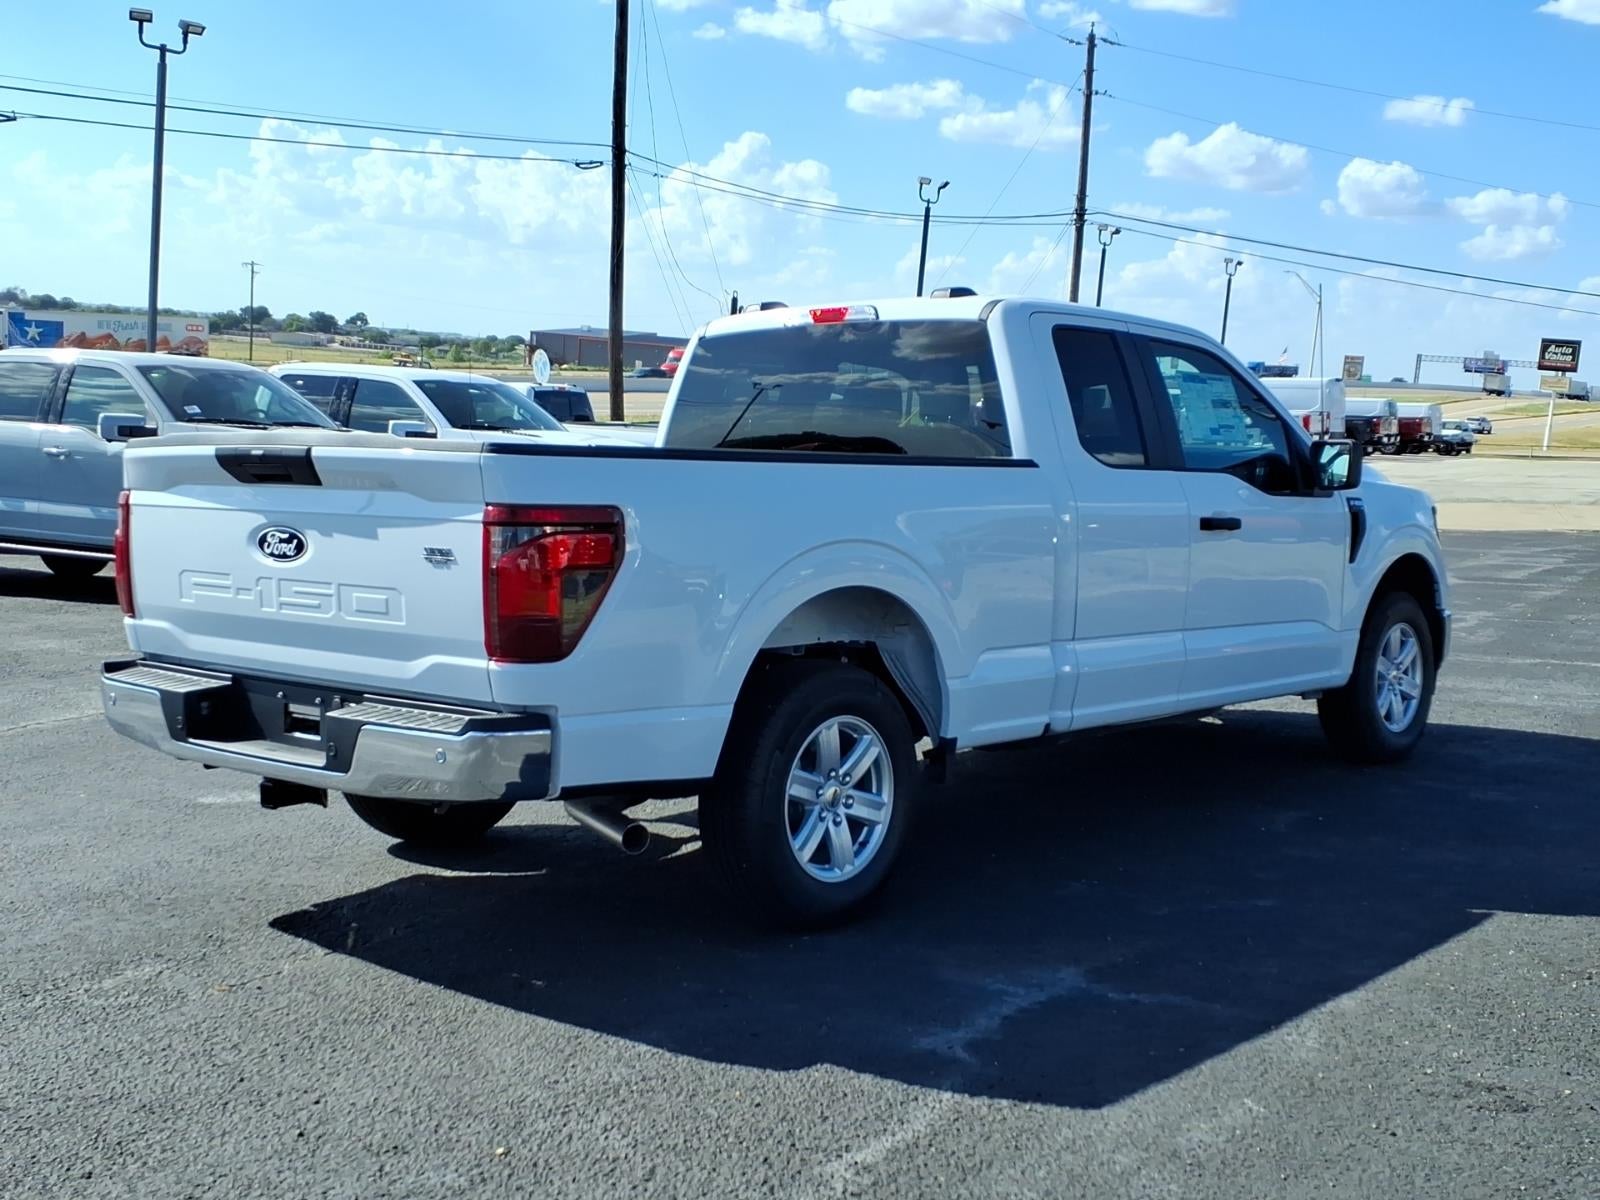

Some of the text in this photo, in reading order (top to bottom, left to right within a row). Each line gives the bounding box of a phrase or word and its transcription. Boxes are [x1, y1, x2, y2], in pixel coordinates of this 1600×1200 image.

[1544, 351, 1573, 362] Value
[1547, 344, 1573, 354] Auto
[262, 530, 298, 556] Ford
[178, 569, 407, 626] F-150
